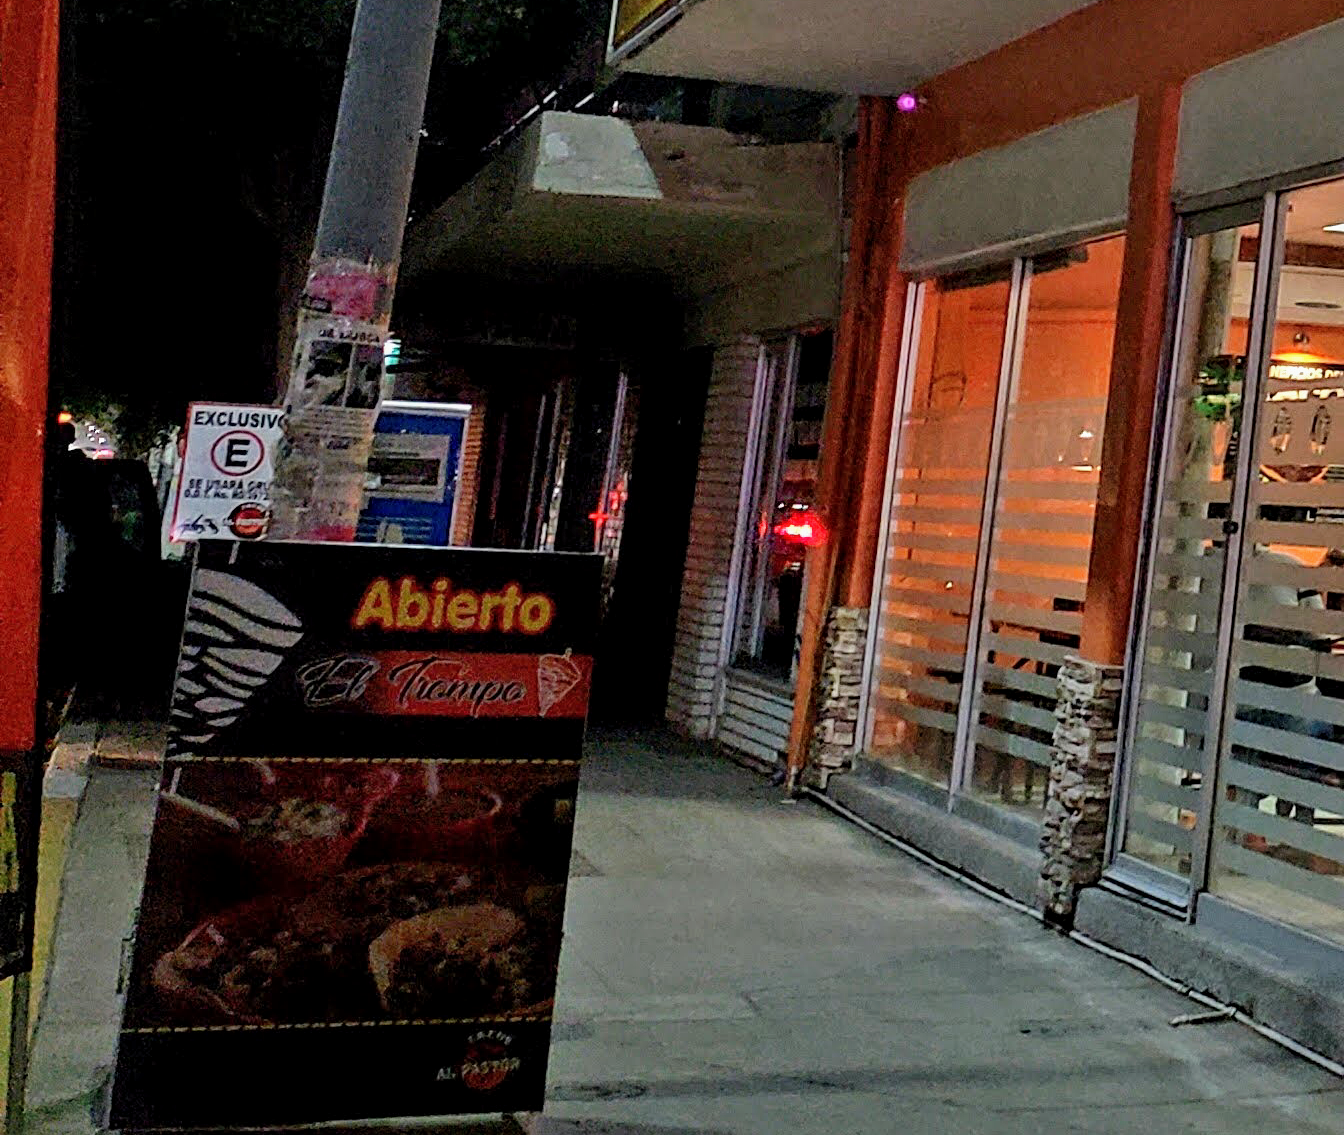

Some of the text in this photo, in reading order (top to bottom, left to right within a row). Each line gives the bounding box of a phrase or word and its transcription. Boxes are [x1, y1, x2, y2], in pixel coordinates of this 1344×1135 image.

[224, 439, 251, 468] E
[354, 576, 554, 633] Abierto
[297, 653, 528, 718] El Trompo
